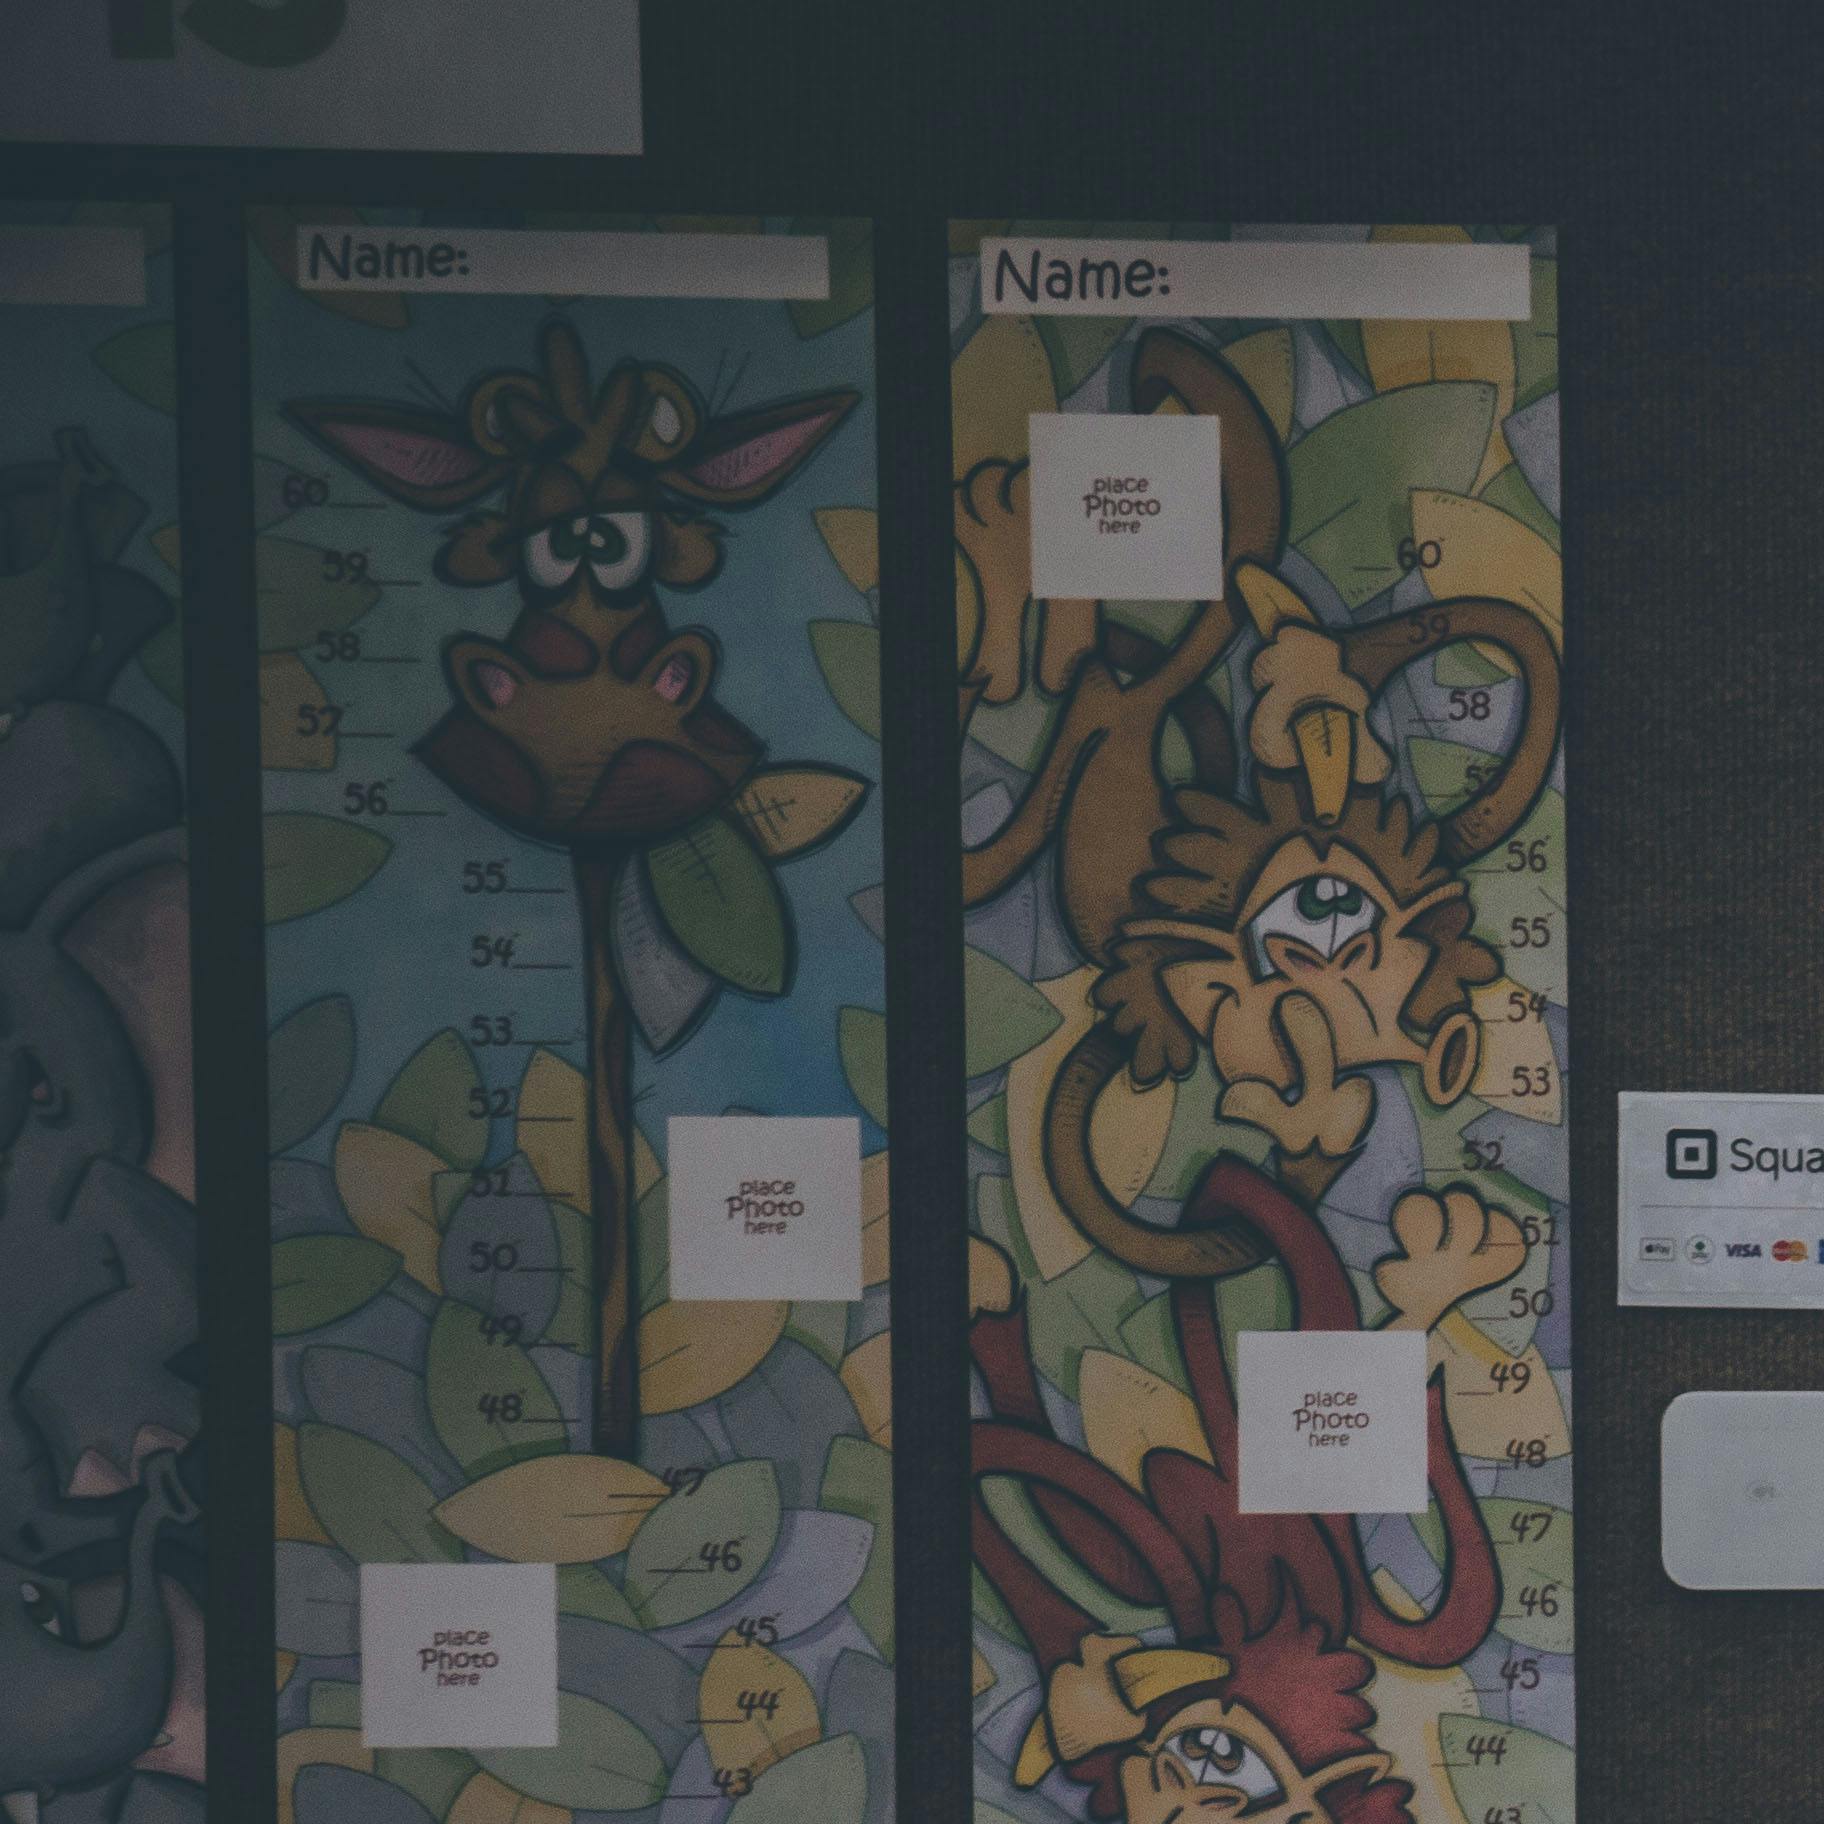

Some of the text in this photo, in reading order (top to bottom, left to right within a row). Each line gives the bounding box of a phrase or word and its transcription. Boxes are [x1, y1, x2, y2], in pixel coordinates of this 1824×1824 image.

[308, 234, 471, 283] Name:
[994, 248, 1172, 302] Name:
[1092, 475, 1150, 495] place
[1082, 493, 1161, 519] Photo
[1099, 517, 1142, 535] here
[738, 1179, 795, 1199] place
[727, 1197, 805, 1219] Photo
[744, 1217, 788, 1237] here
[1724, 1242, 1764, 1259] VISA
[1302, 1389, 1359, 1408] place
[1293, 1406, 1370, 1432] Photo
[1308, 1430, 1351, 1449] here
[433, 1629, 490, 1650] place
[419, 1647, 500, 1673] Photo
[436, 1668, 481, 1687] here
